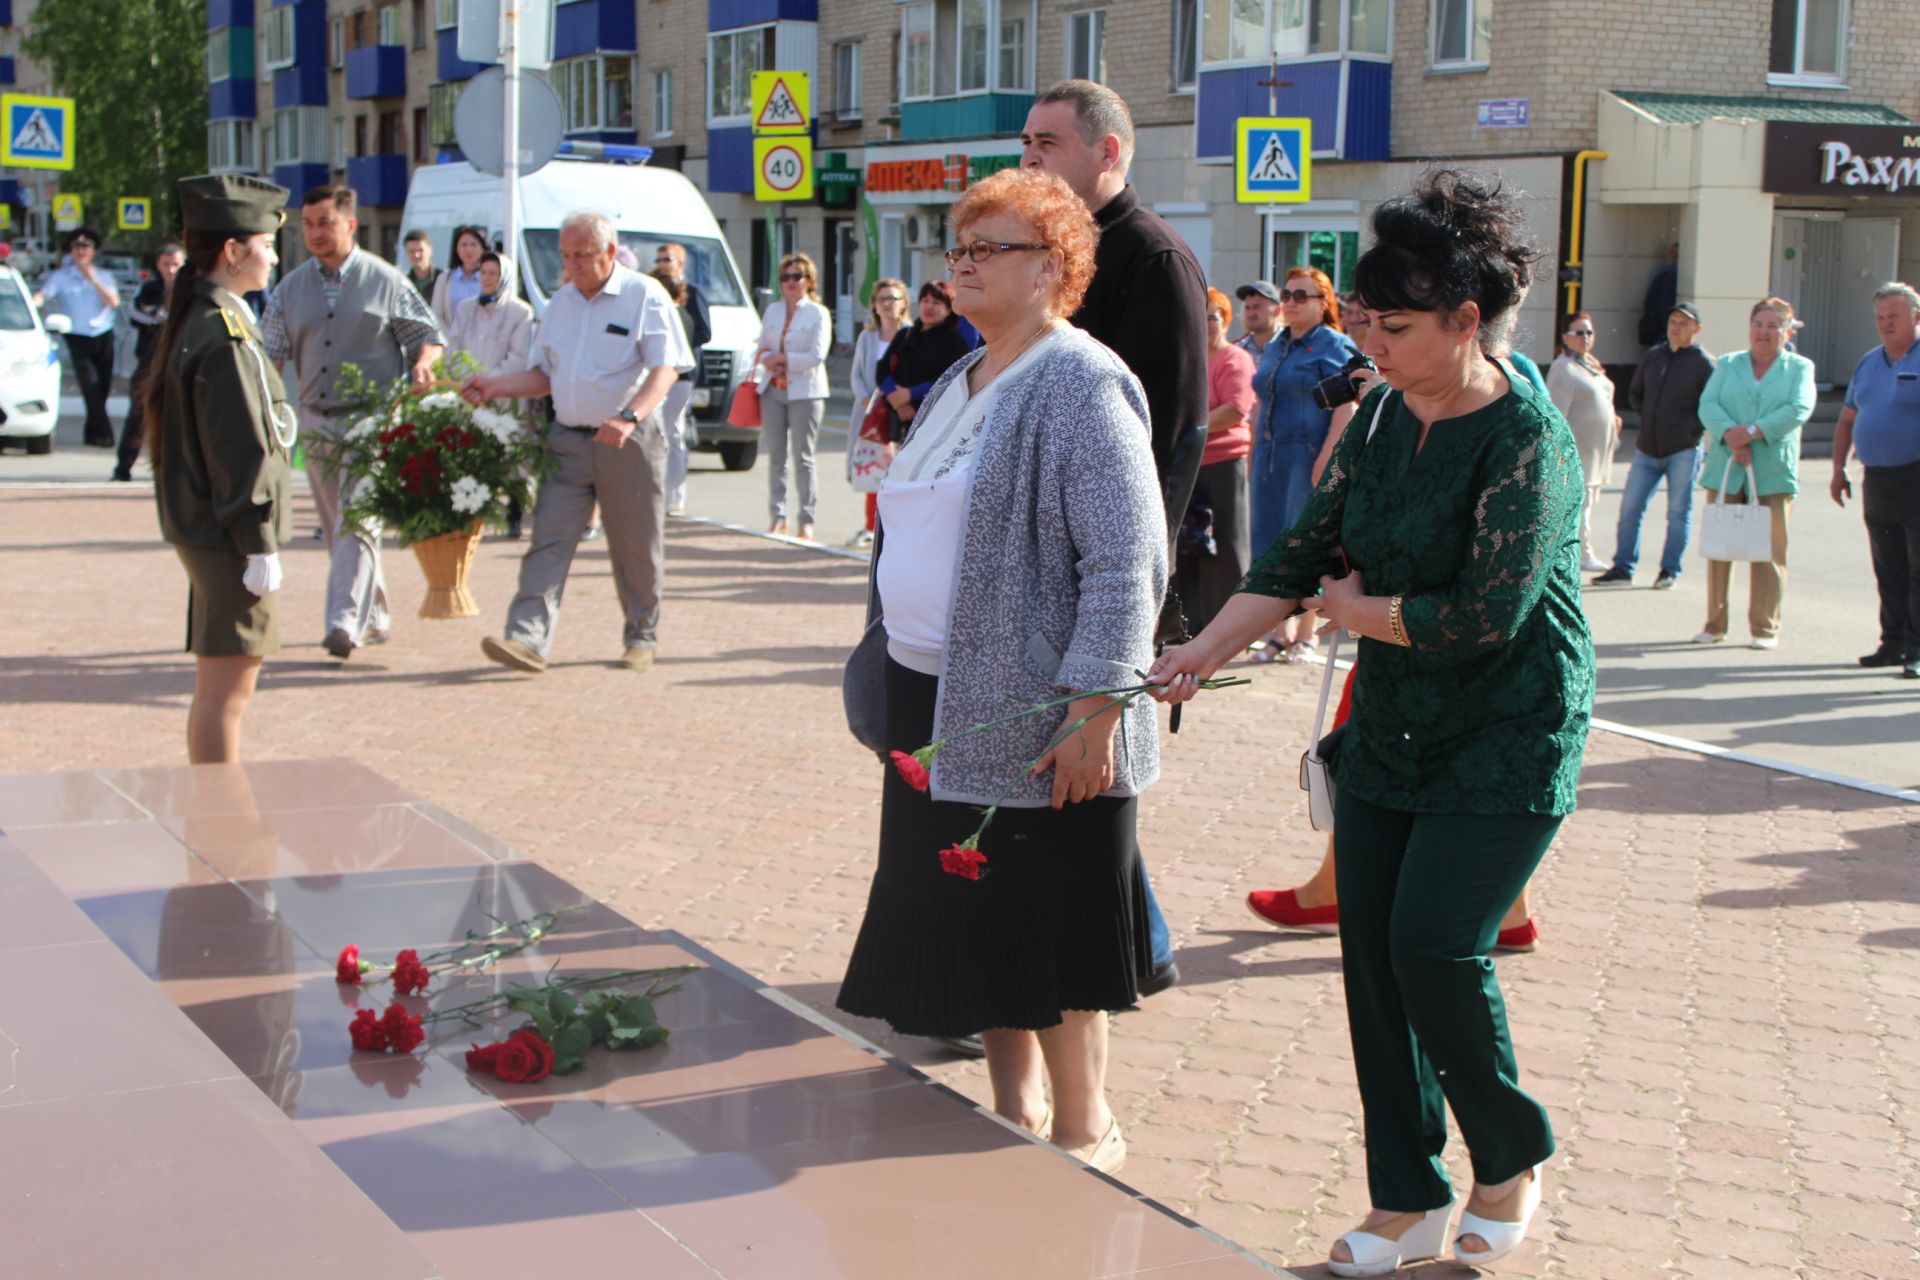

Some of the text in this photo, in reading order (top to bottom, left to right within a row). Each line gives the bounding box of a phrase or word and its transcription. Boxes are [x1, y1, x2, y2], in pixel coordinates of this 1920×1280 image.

[770, 160, 796, 177] 40
[820, 172, 857, 182] АПТЕКА
[864, 158, 945, 192] АПТЕКА
